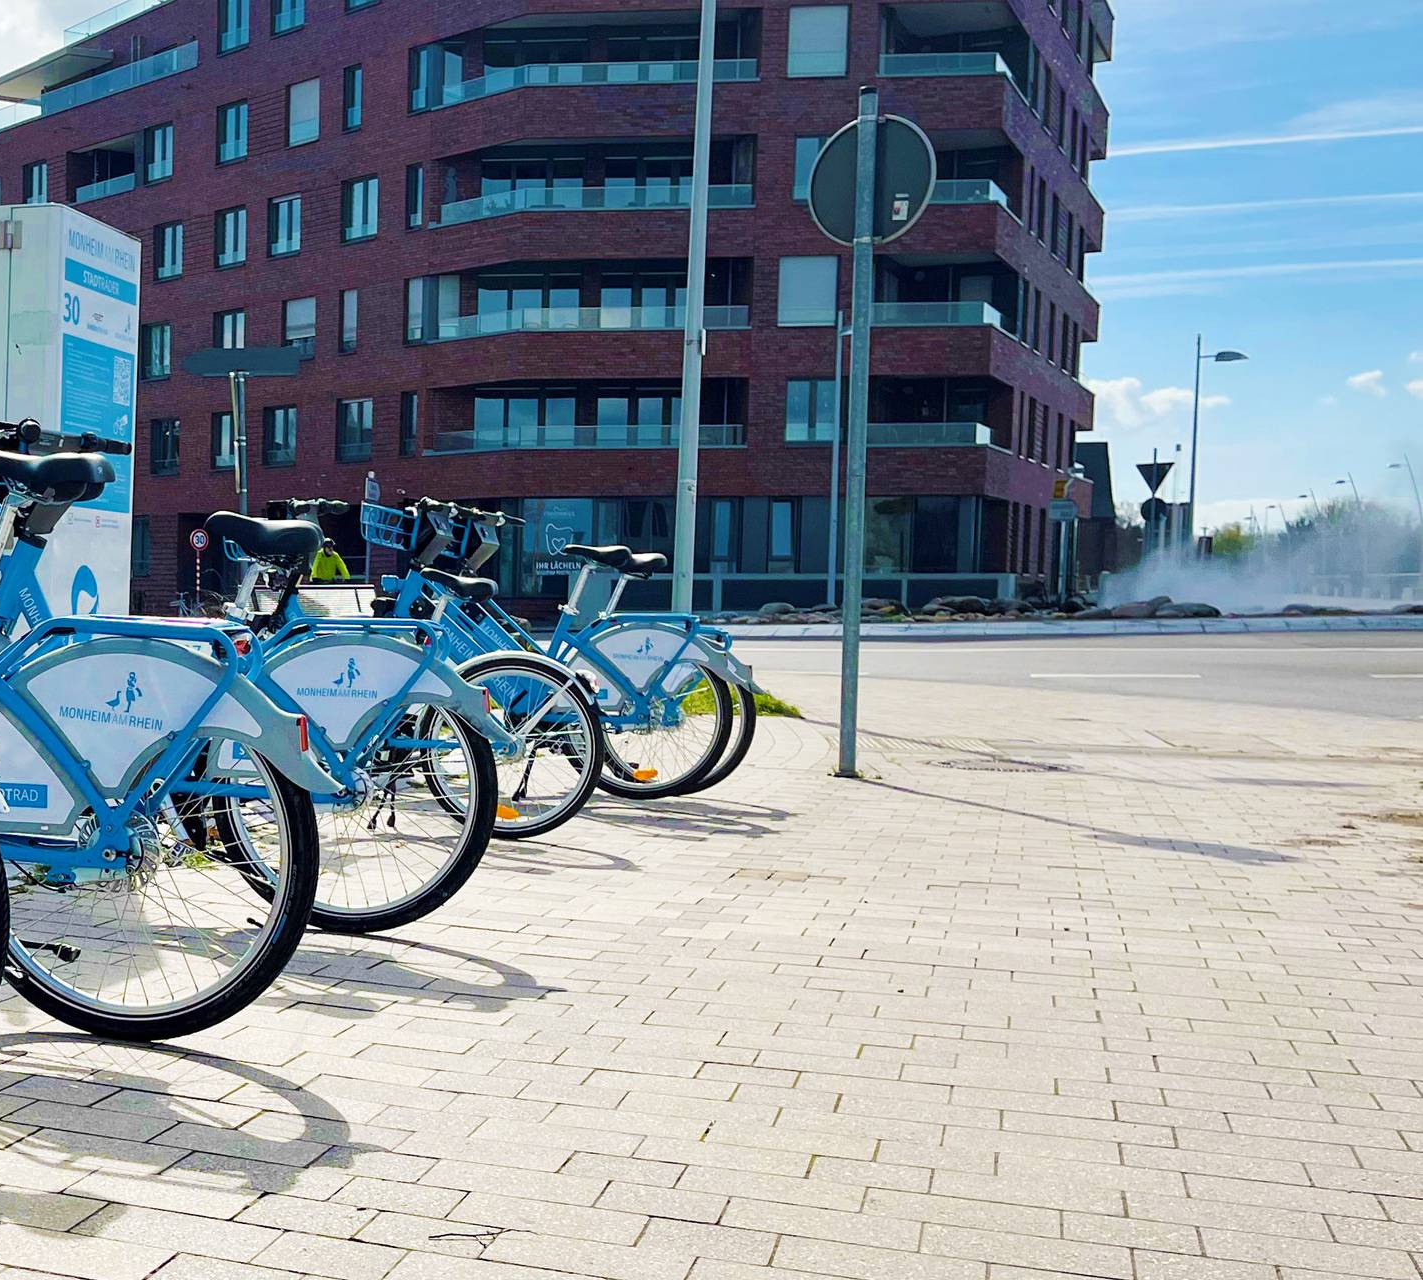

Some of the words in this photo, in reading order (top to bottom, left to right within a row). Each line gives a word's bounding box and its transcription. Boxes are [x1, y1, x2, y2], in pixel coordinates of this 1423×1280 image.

[63, 292, 80, 325] 30
[536, 561, 550, 570] IHR
[19, 587, 42, 625] MONH
[297, 687, 338, 697] MONHEIM
[59, 705, 112, 724] MONHEIM
[129, 715, 163, 731] RHEIN
